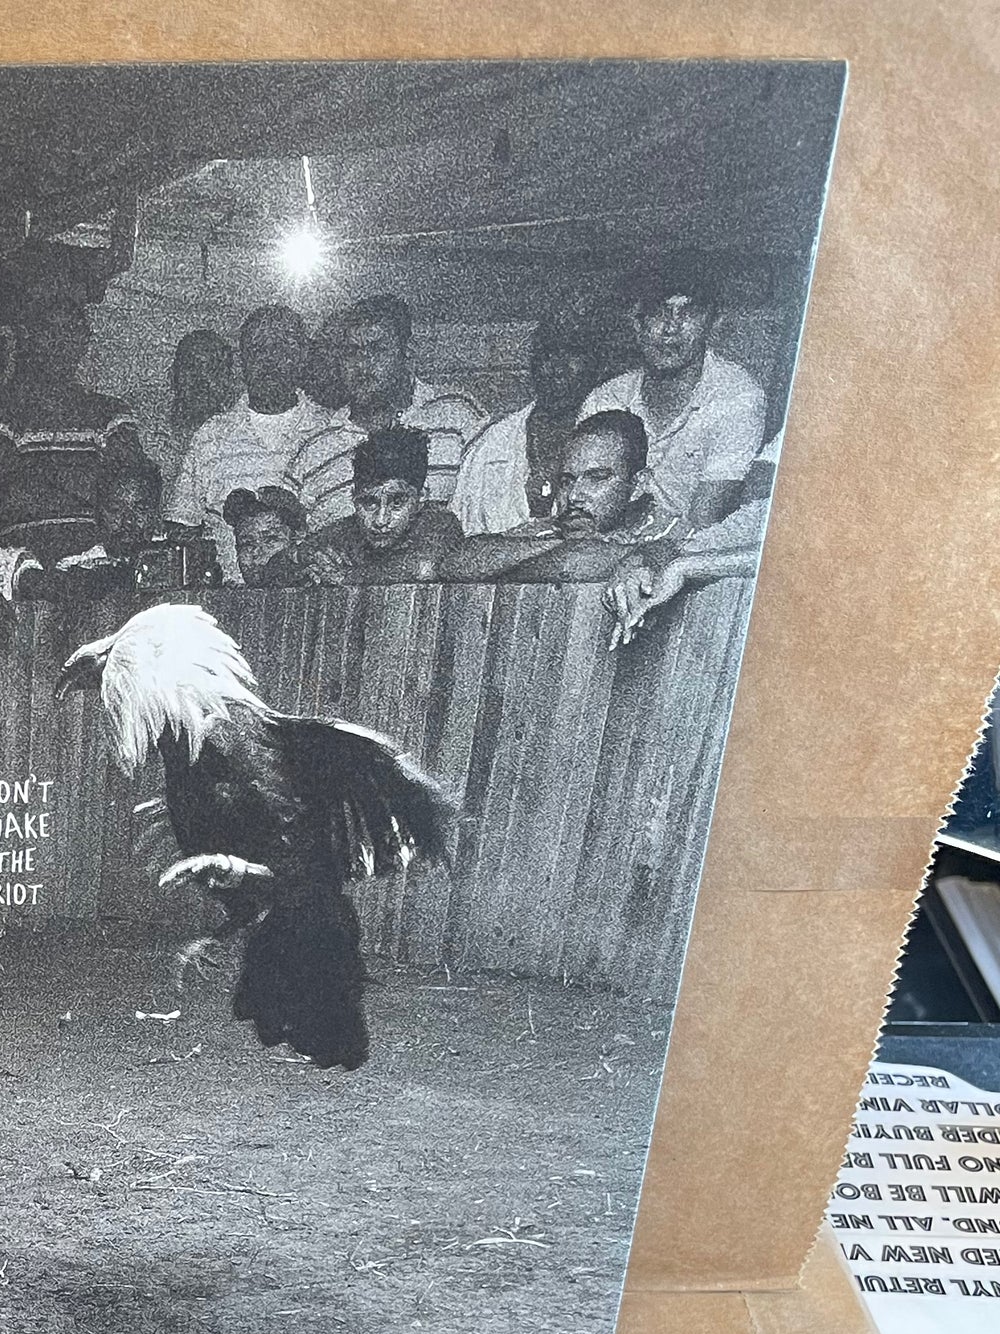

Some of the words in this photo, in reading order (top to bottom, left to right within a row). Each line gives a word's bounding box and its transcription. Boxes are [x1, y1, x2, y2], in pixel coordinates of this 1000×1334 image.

[866, 1073, 951, 1089] RECEI
[879, 1153, 951, 1171] FULL
[832, 1182, 882, 1201] BO
[887, 1184, 927, 1202] BE
[878, 1215, 933, 1231] ALL
[881, 1244, 954, 1264] NEW
